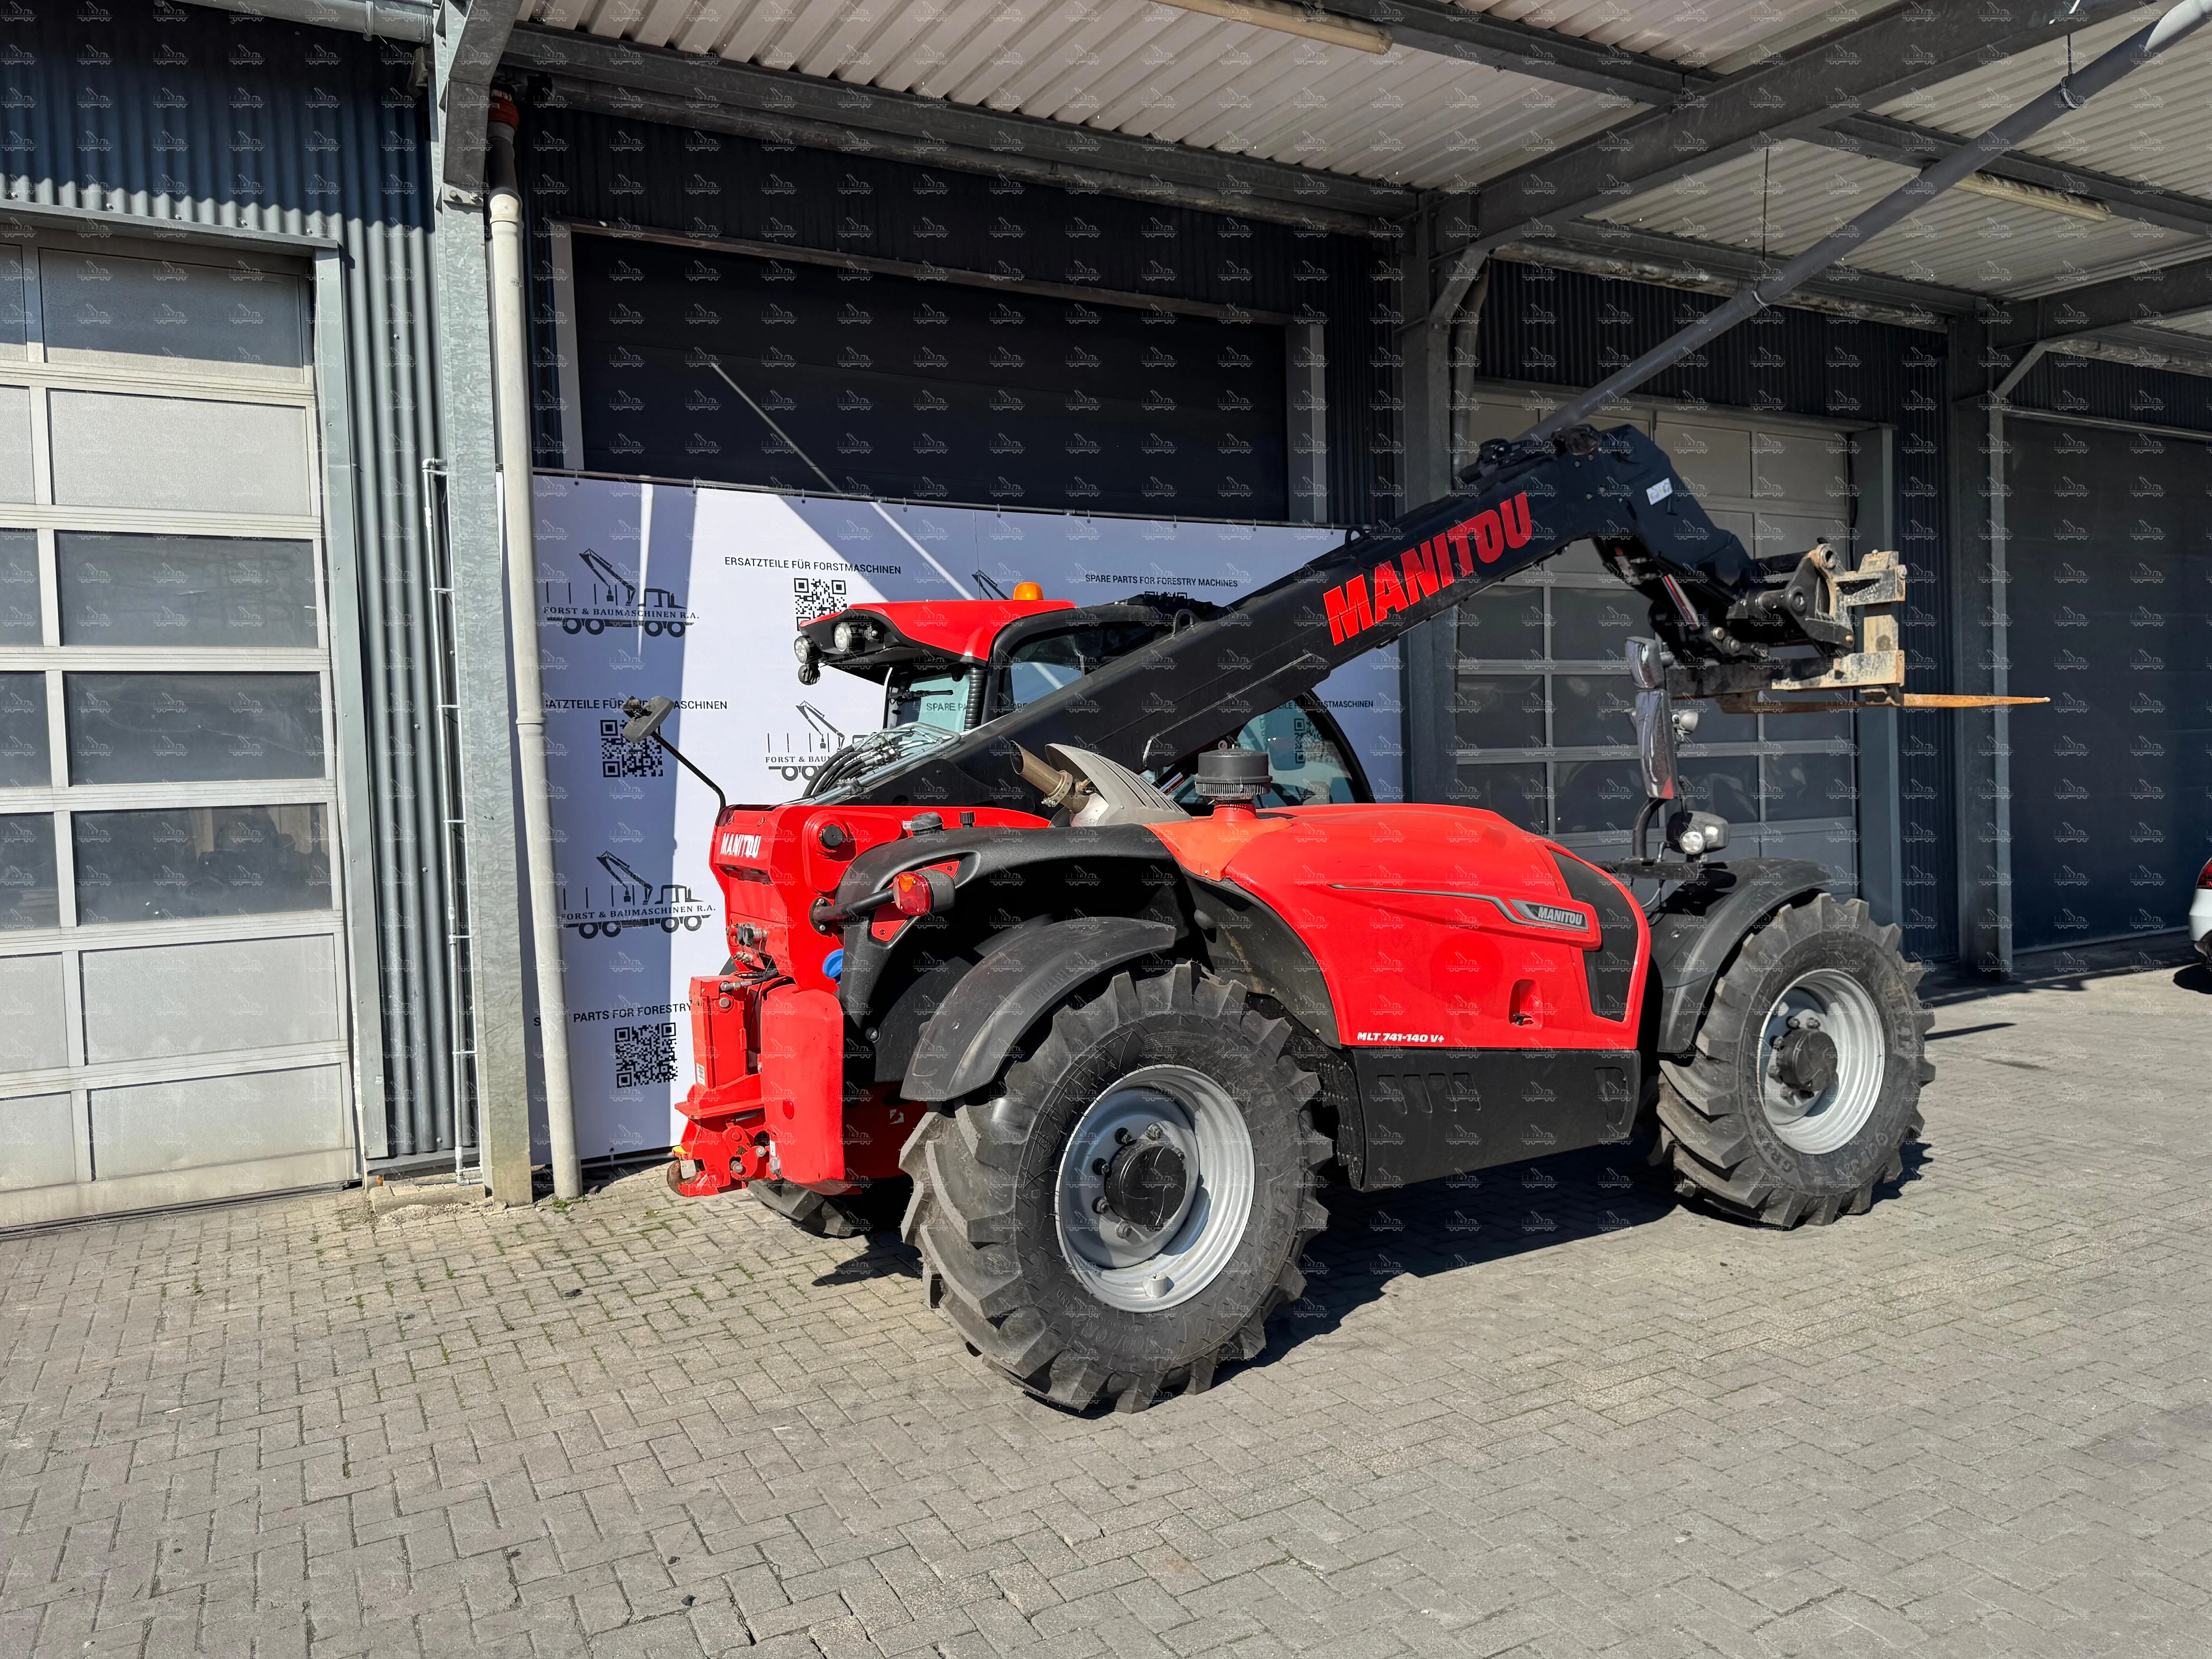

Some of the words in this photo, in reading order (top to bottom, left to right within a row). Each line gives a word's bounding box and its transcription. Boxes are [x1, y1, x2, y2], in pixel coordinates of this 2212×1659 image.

[725, 557, 789, 568] ERSATZTEILE
[791, 559, 811, 570] FÜR
[814, 562, 901, 575] FORSTMASCHINEN
[1323, 491, 1532, 646] MANITOU
[1085, 574, 1111, 582] SPARE
[1113, 575, 1138, 584] PARTS
[1157, 577, 1196, 586] FORESTRY
[1198, 578, 1238, 587] MACHINES
[593, 608, 676, 618] BAUMASCHINEN
[720, 833, 762, 858] MANITOU
[561, 912, 595, 920] FORST
[610, 906, 693, 917] BAUMASCHINEN
[1538, 907, 1583, 925] MANITOU
[573, 1011, 610, 1023] PARTS
[613, 1008, 634, 1019] FOR
[638, 1002, 691, 1016] FORESTRY
[1357, 1032, 1381, 1041] MLT
[1382, 1033, 1428, 1042] 741-140
[1430, 1034, 1445, 1042] V+
